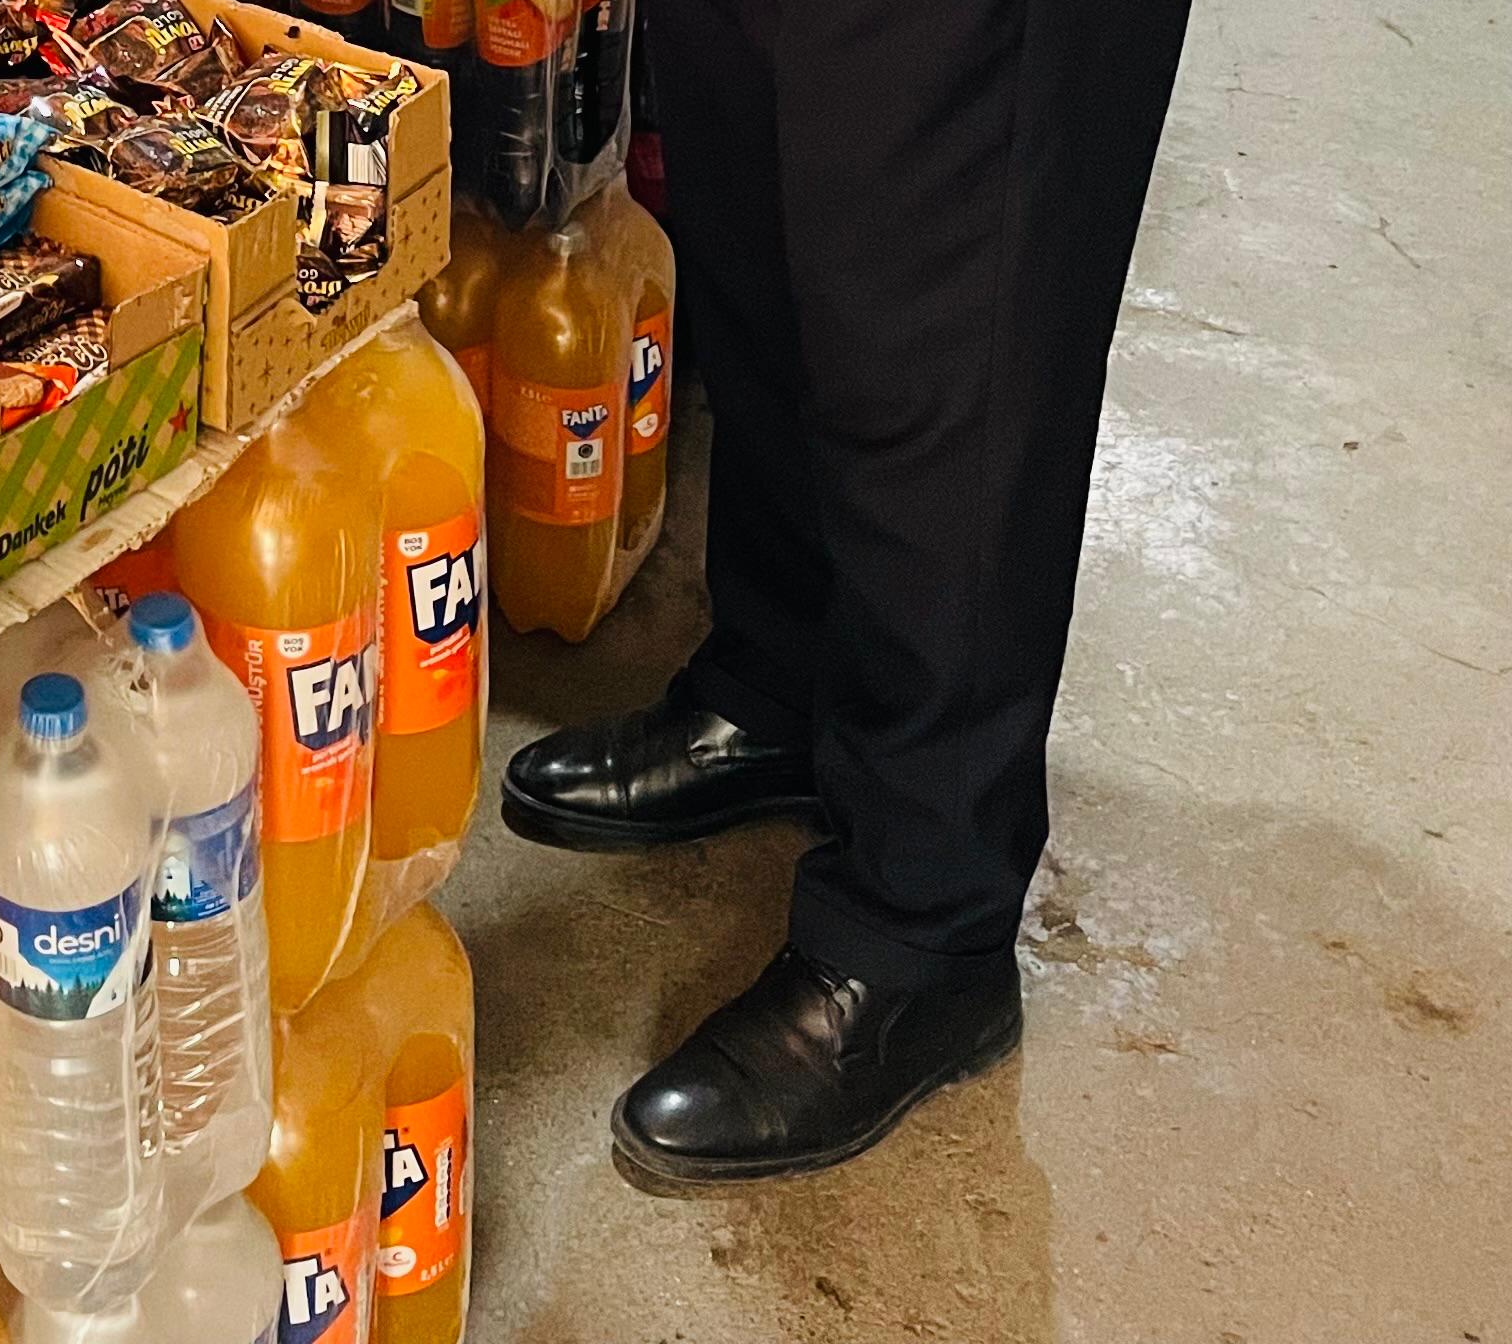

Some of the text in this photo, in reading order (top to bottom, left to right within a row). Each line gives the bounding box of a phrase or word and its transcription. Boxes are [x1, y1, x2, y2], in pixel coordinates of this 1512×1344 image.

[561, 403, 608, 425] FANTA
[78, 423, 151, 521] pöti
[33, 914, 123, 962] desni
